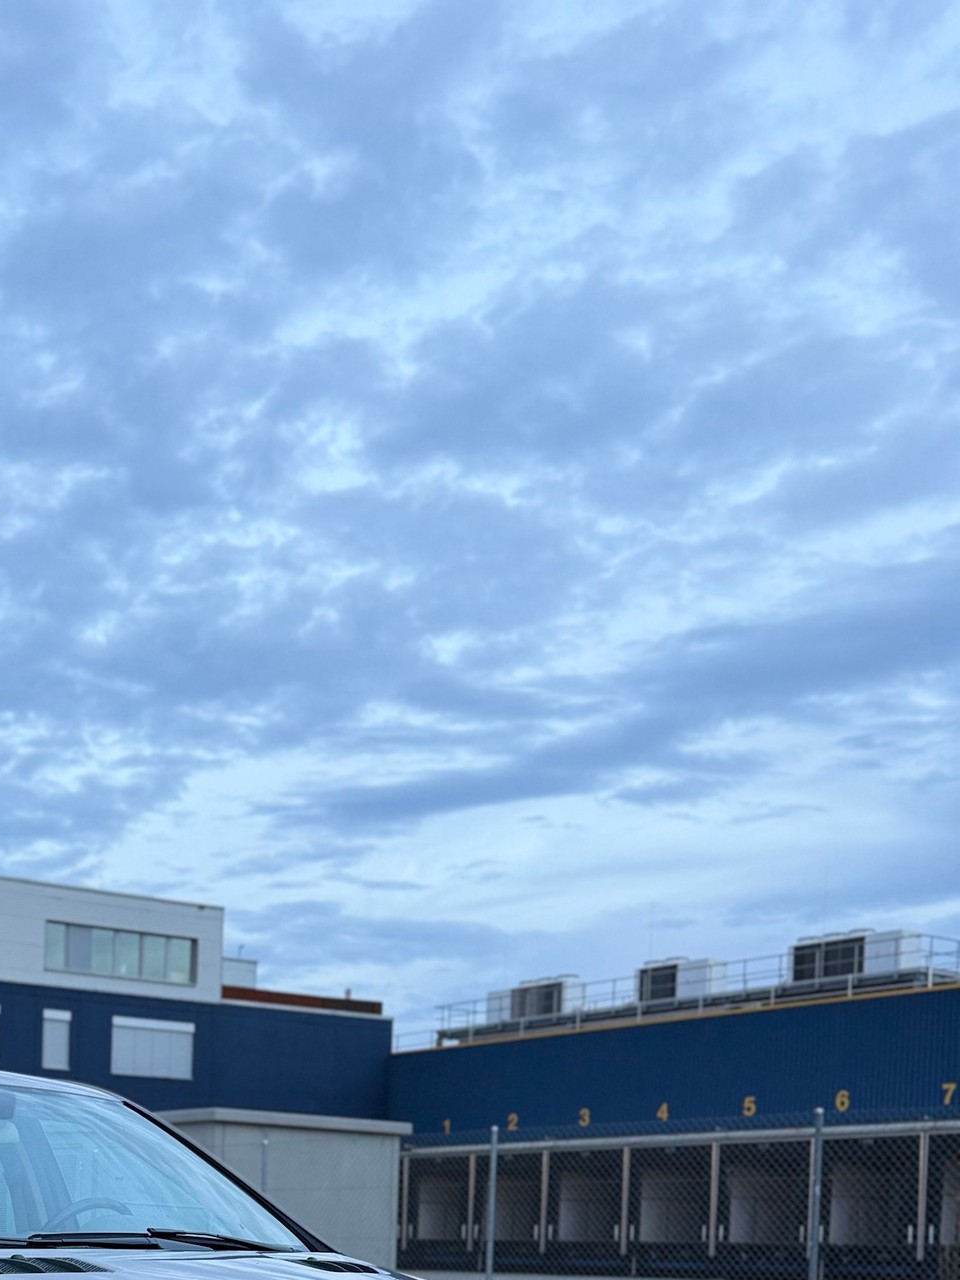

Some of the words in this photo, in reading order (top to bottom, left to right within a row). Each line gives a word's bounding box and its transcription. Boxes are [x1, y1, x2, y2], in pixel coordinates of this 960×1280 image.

[834, 1090, 850, 1112] 6
[941, 1083, 957, 1105] 7
[656, 1103, 669, 1121] 4
[742, 1096, 757, 1117] 5
[442, 1119, 452, 1133] 1
[507, 1114, 519, 1131] 2
[579, 1108, 591, 1127] 3
